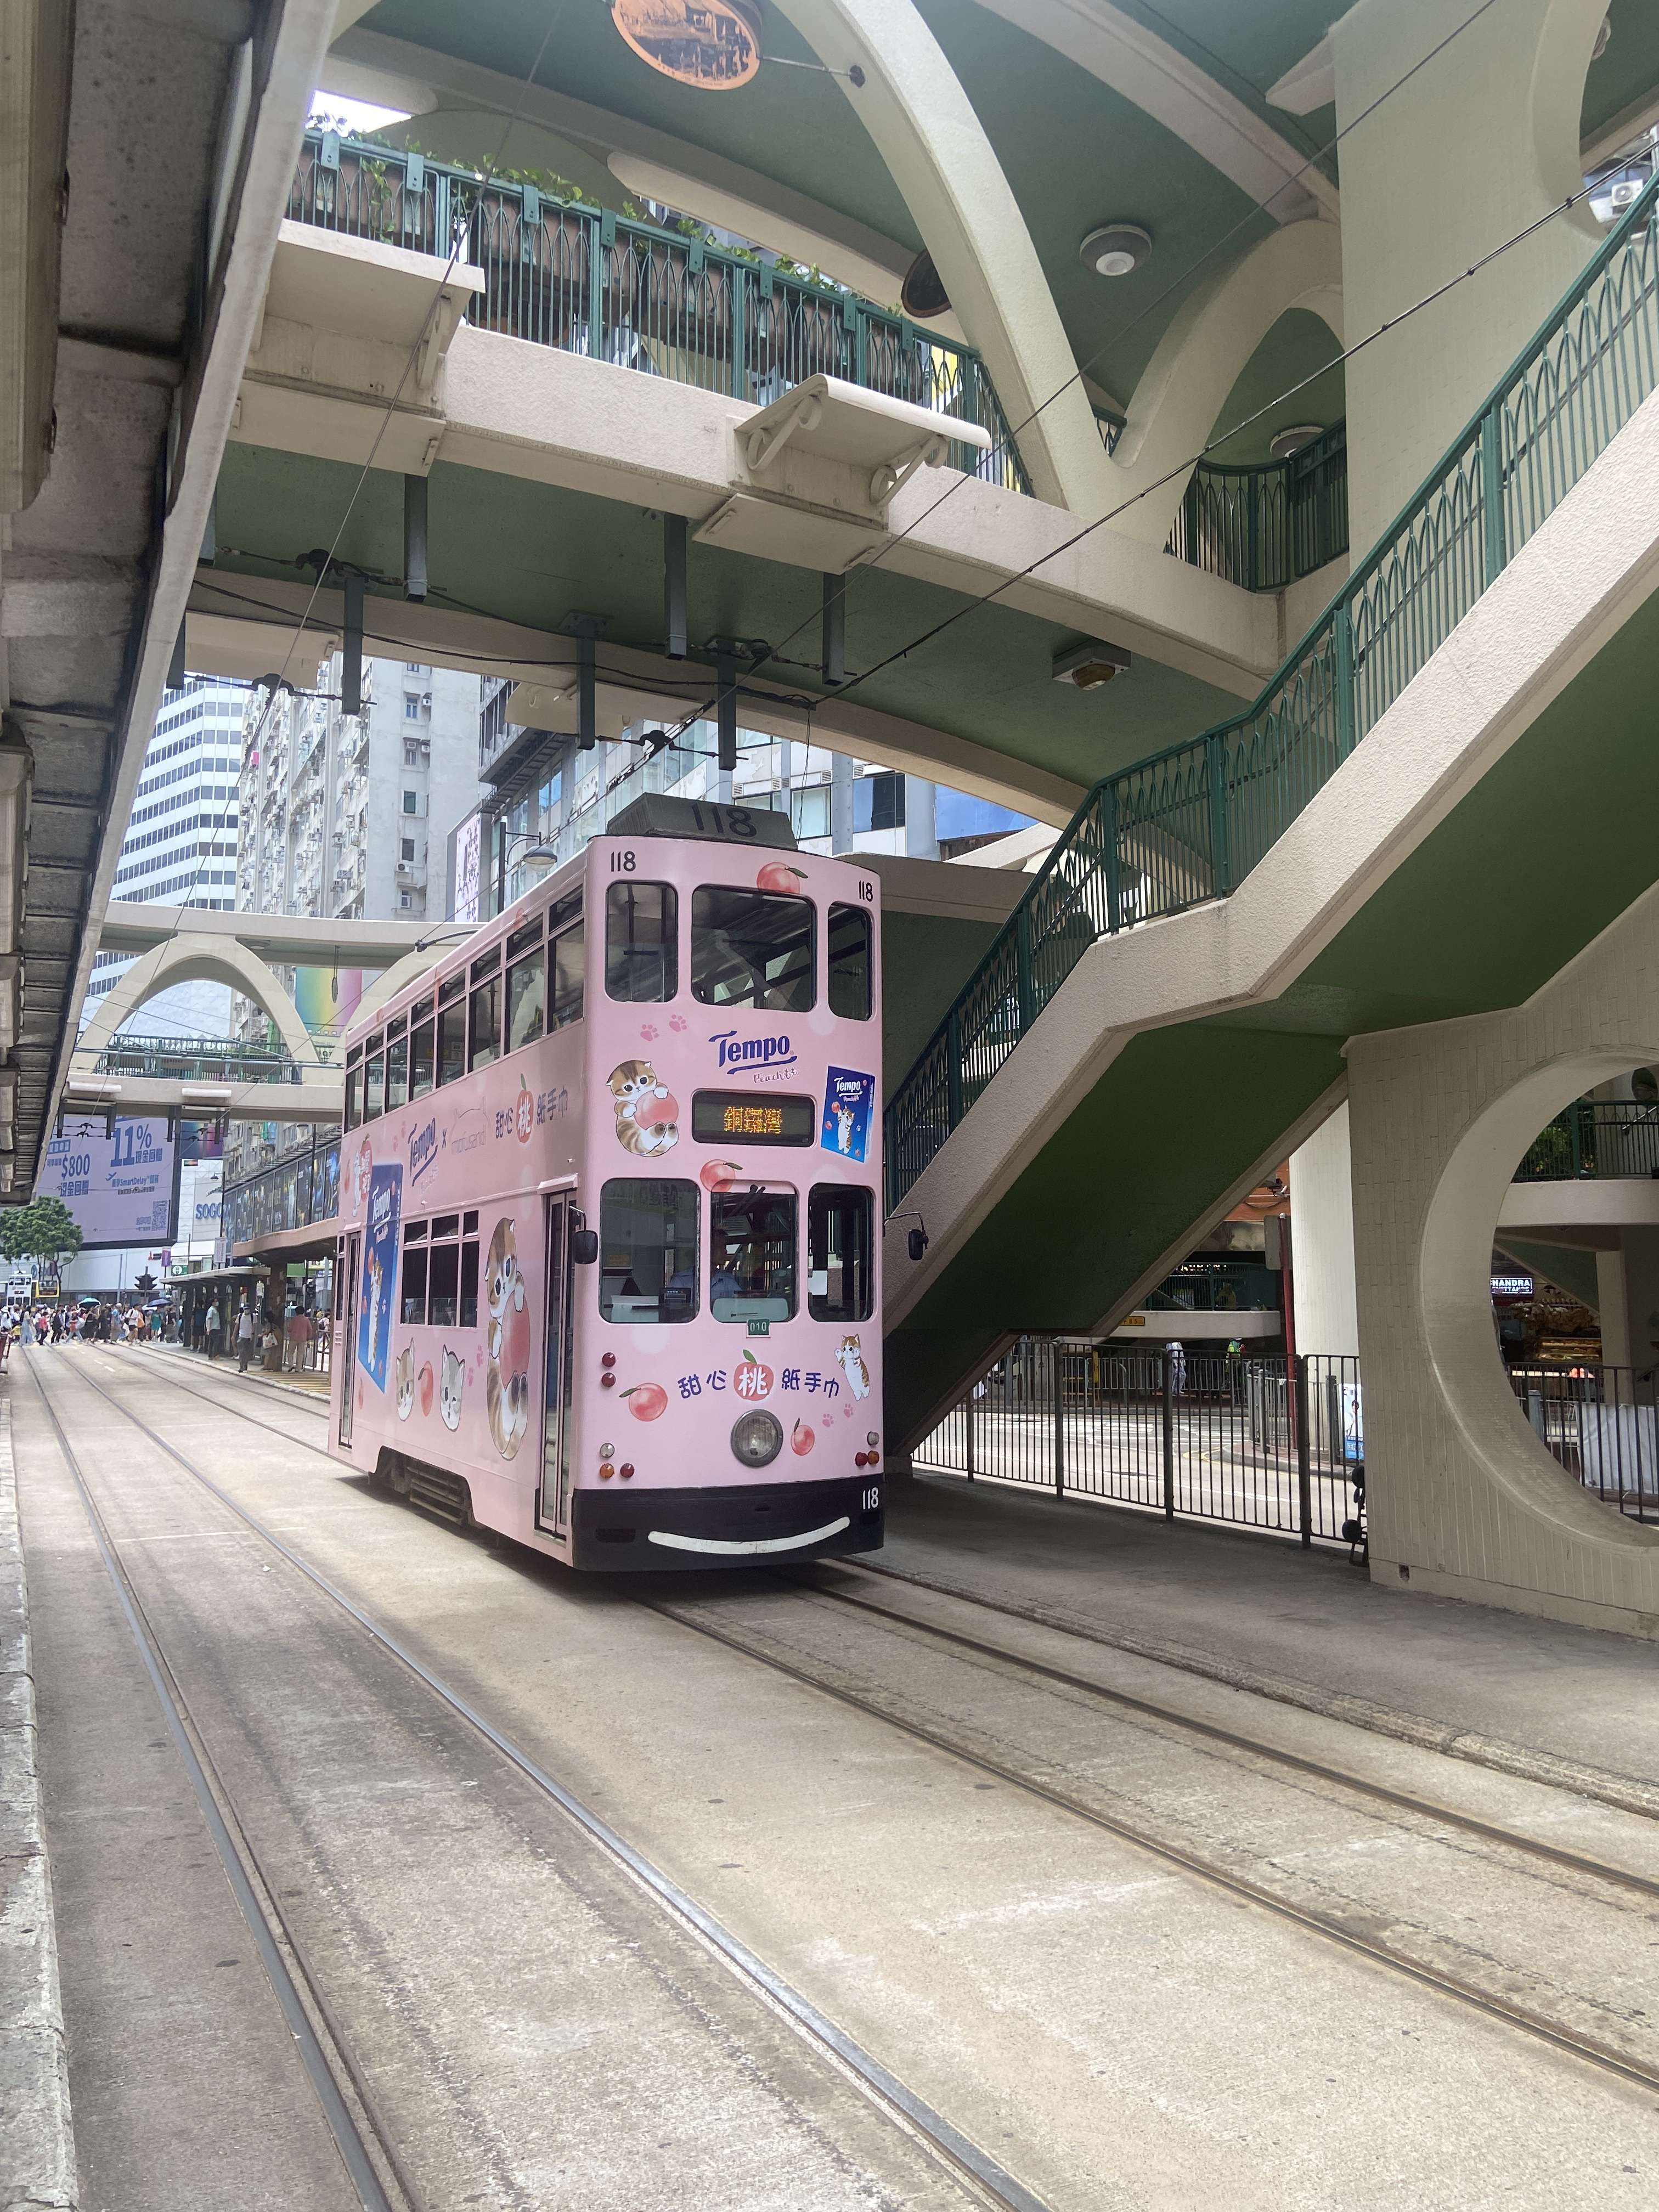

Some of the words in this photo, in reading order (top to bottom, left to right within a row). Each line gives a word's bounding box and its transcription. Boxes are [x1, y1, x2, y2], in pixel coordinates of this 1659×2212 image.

[690, 803, 758, 837] 118
[611, 851, 637, 872] 118
[859, 881, 874, 902] 118
[724, 1106, 782, 1135] 銅鑼灣
[110, 1124, 152, 1167] 11%
[61, 1154, 91, 1180] $800
[750, 1321, 766, 1332] 010
[677, 1366, 840, 1398] 甜心桃紙手巾
[862, 1487, 879, 1510] 118
